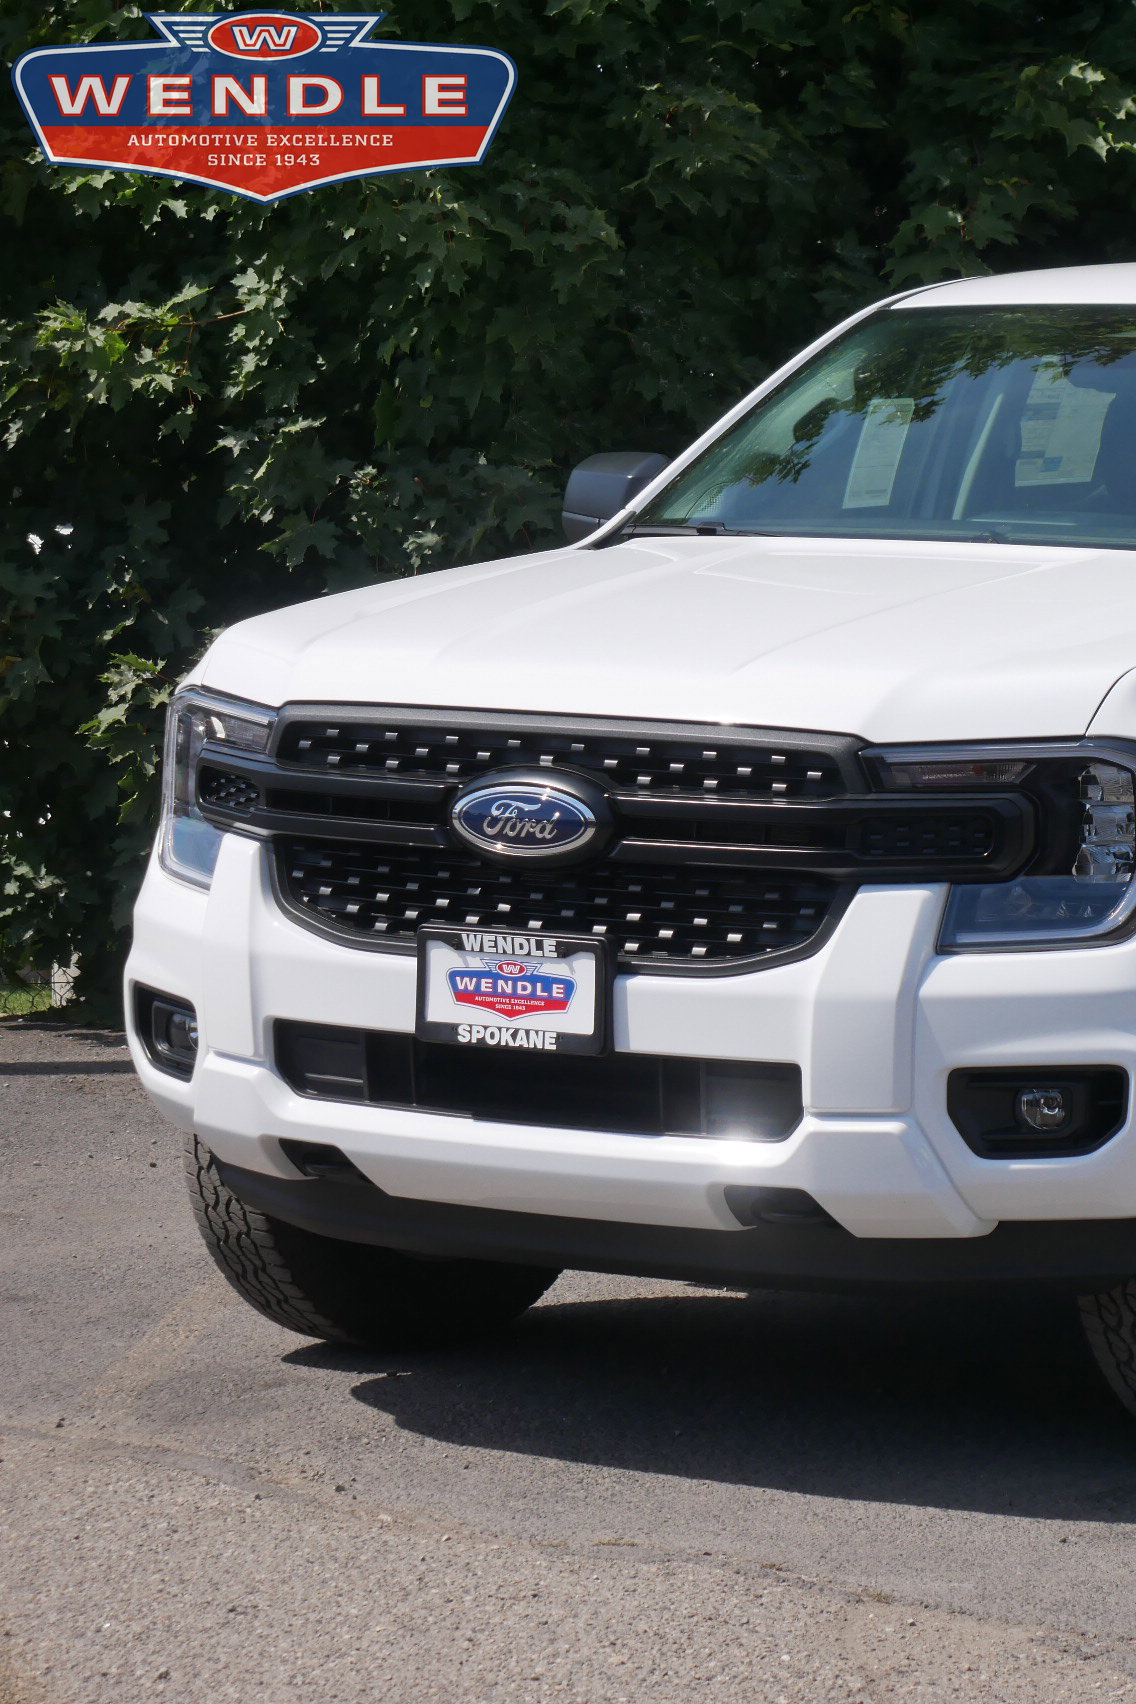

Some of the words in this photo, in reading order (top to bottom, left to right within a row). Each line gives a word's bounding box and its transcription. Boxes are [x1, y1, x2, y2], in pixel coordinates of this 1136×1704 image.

[483, 799, 560, 840] Ford
[462, 933, 558, 958] WENDLE
[455, 976, 566, 998] WENDLE
[475, 996, 510, 1004] AUTOMOTIVE
[511, 998, 545, 1006] EXCELLENCE
[457, 1023, 557, 1050] SPOKANE
